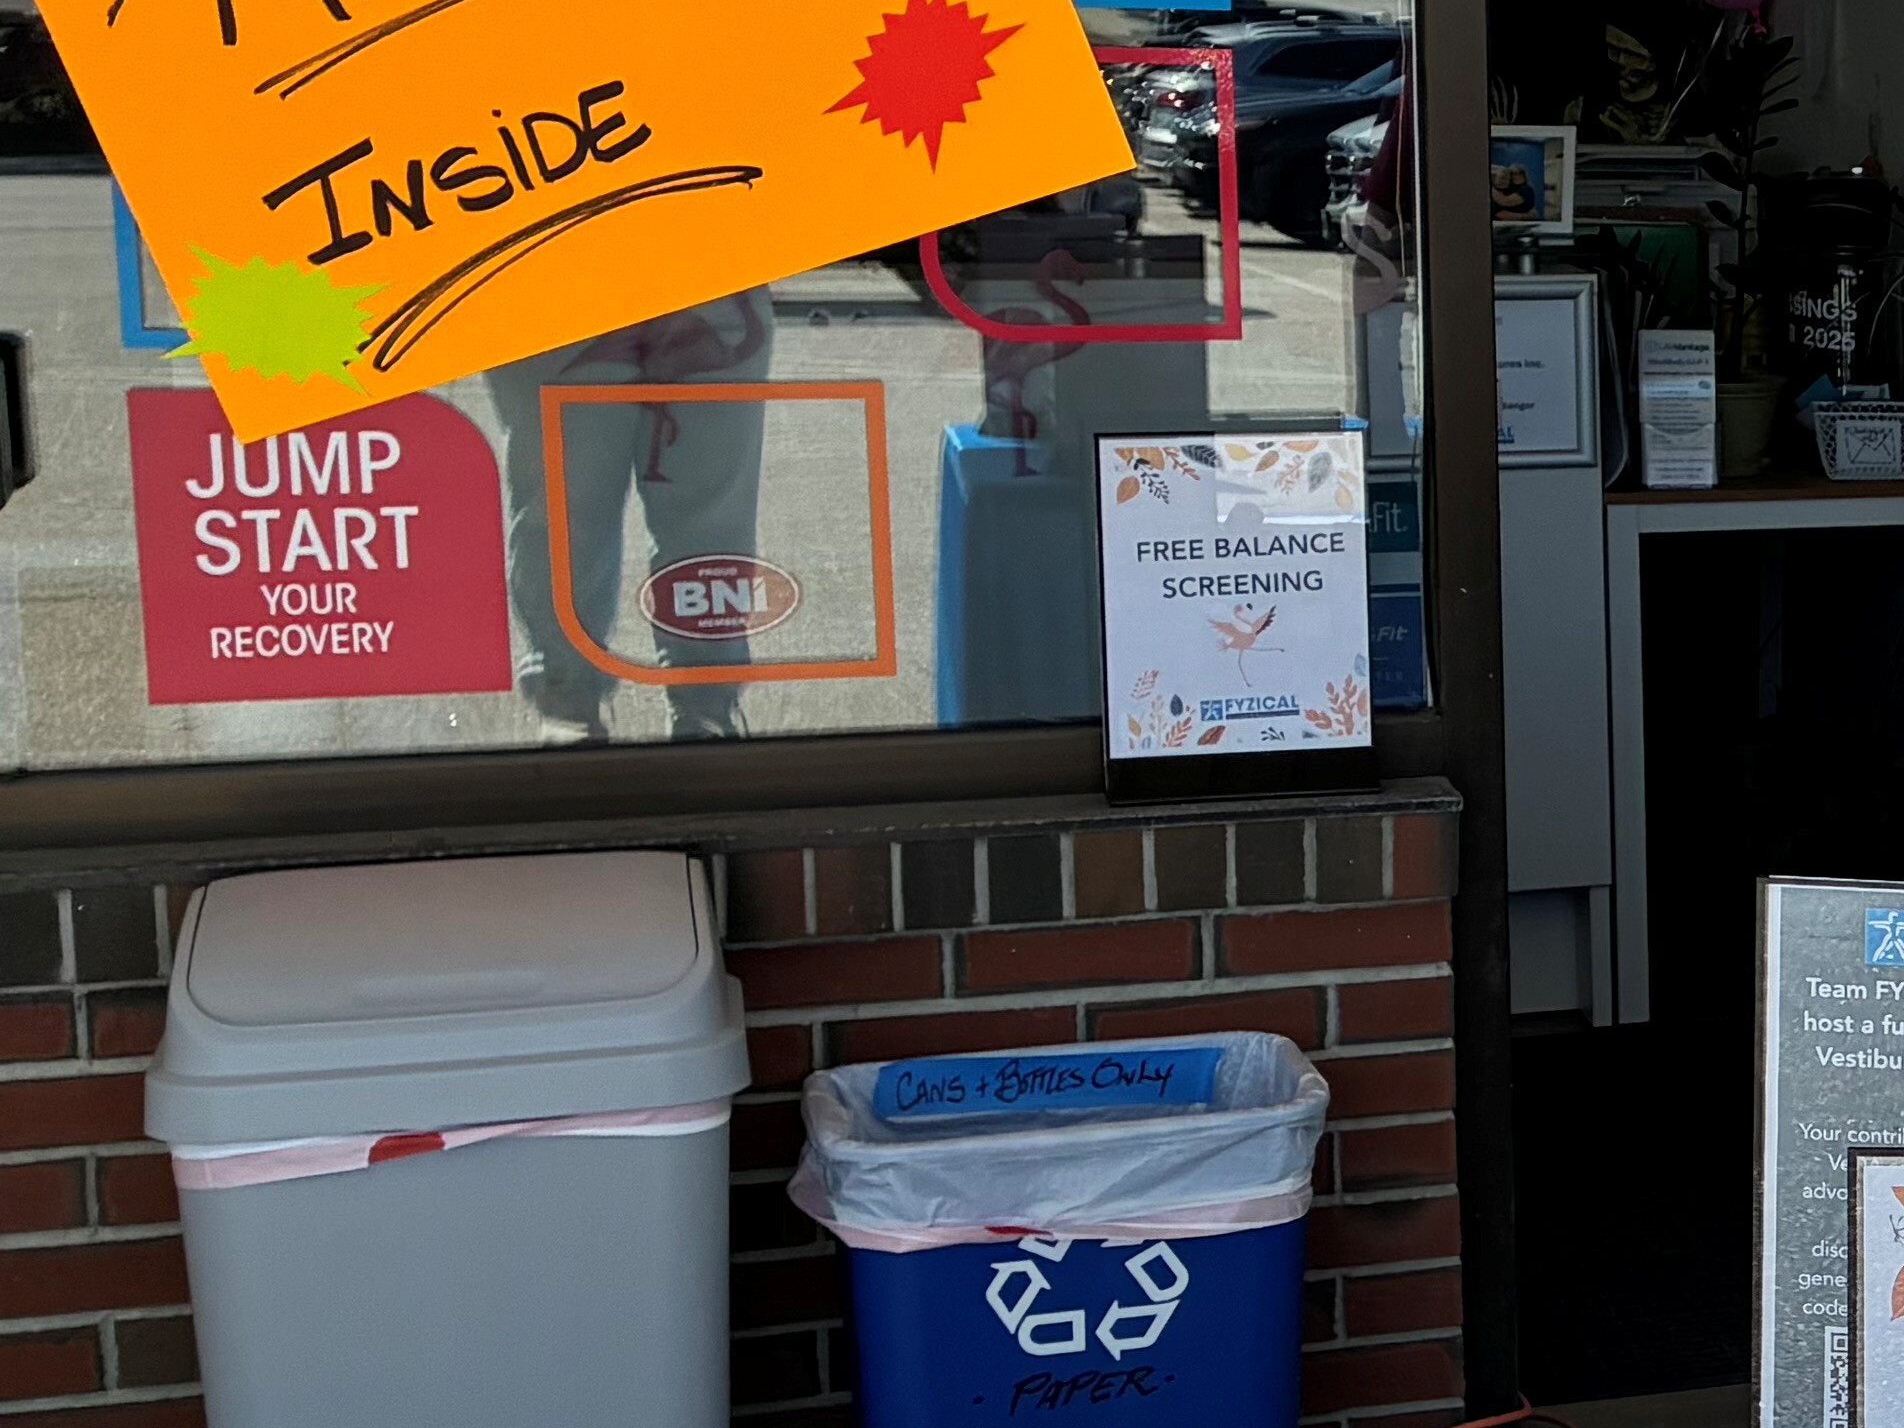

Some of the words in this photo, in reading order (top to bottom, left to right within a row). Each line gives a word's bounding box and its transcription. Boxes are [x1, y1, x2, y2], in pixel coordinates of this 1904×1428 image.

[183, 429, 404, 503] JUMP
[191, 504, 421, 578] START
[1136, 536, 1206, 563] FREE
[1213, 531, 1346, 559] BALANCE
[260, 582, 359, 618] YOUR
[1160, 571, 1325, 600] SCREENING
[207, 621, 397, 662] RECOVERY
[1223, 693, 1302, 716] FYZICAL
[1805, 977, 1868, 1001] Team
[1803, 1011, 1855, 1034] host
[1861, 1019, 1875, 1035] a
[896, 1071, 967, 1110] CANS
[975, 1076, 992, 1099] +
[1091, 1058, 1174, 1096] ONLY
[1799, 1123, 1842, 1142] Your
[1798, 1272, 1849, 1290] gene
